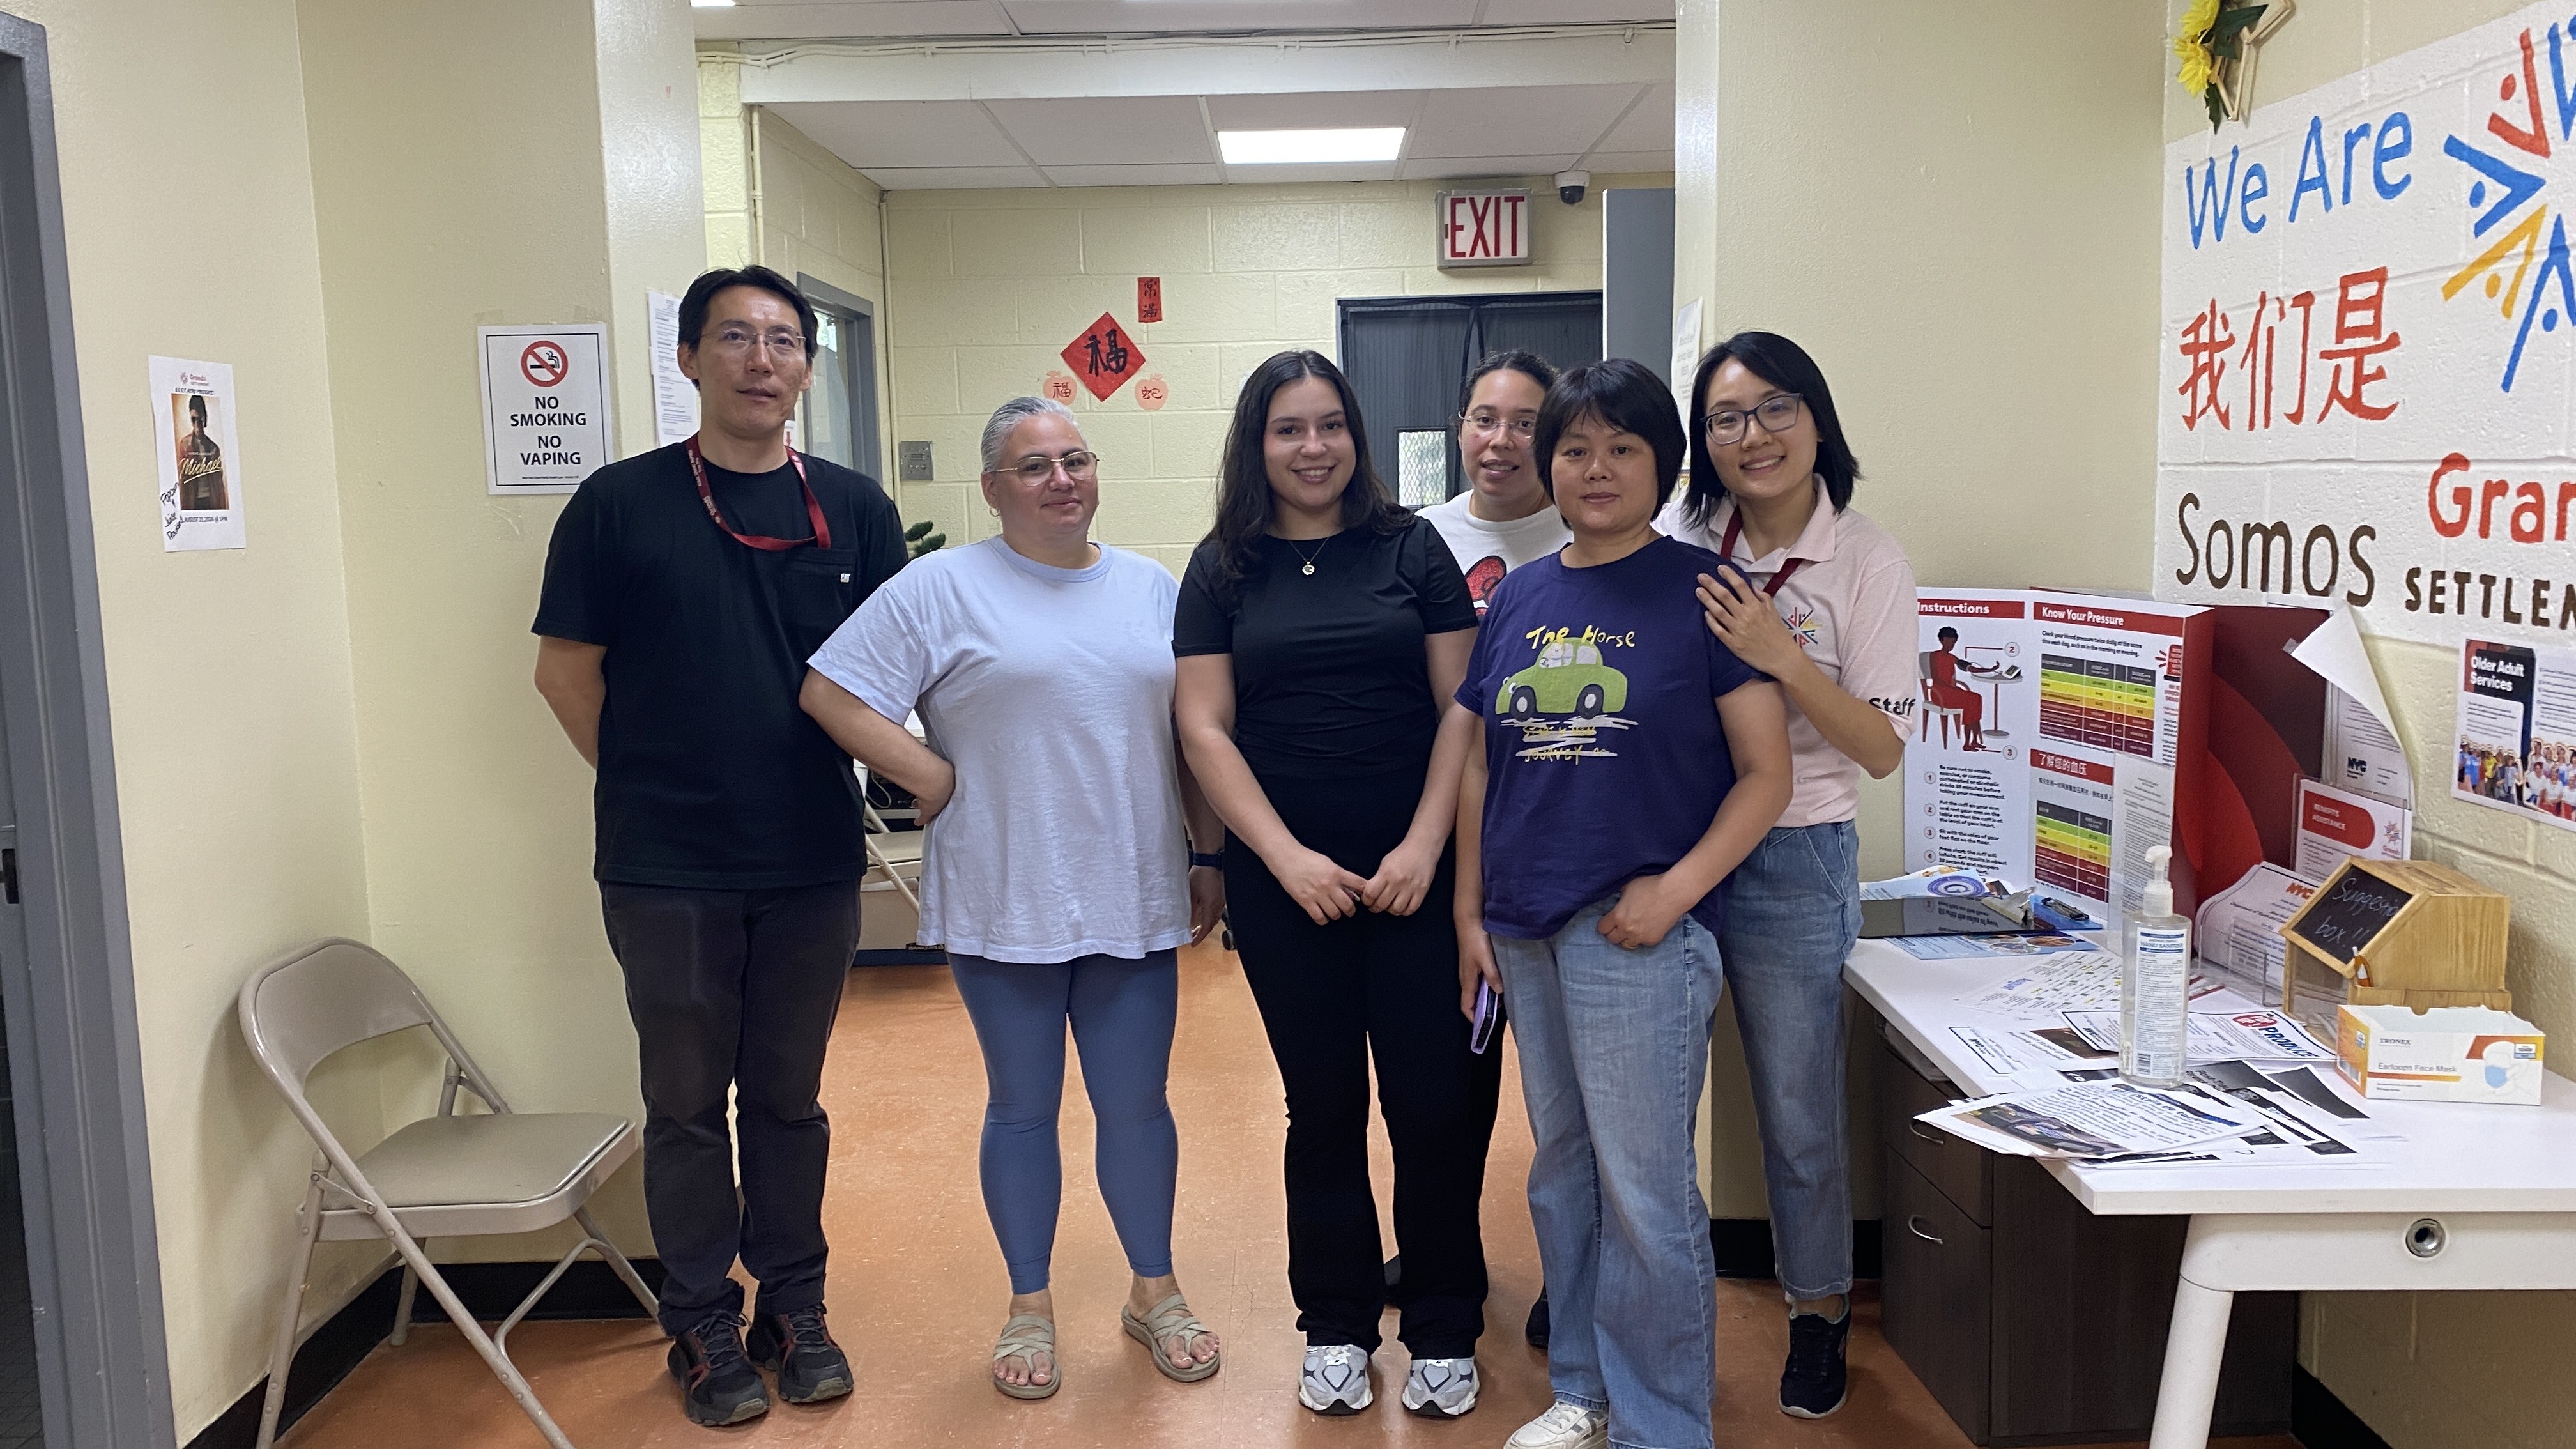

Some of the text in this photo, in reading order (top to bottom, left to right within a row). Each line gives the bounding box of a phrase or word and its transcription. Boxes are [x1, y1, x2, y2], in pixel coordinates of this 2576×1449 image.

[2186, 112, 2412, 250] We Are
[1450, 197, 1524, 257] EXIT
[1084, 328, 1128, 377] 福
[2179, 266, 2401, 431] 我们是
[1053, 382, 1071, 398] 福
[1142, 386, 1163, 399] 蛇
[535, 397, 558, 409] NO
[510, 413, 586, 427] SMOKING
[537, 435, 561, 448] NO
[179, 456, 221, 477] Michael
[521, 452, 581, 465] VAPING
[2175, 492, 2377, 607] Somos
[1918, 601, 1989, 615] Instructions
[2042, 606, 2124, 626] Know Your Pressure
[1581, 625, 1635, 648] Horse
[2471, 656, 2524, 677] Older Adult
[2469, 671, 2513, 692] Services
[1869, 698, 1916, 716] Staff
[2378, 1063, 2412, 1071] Earloops
